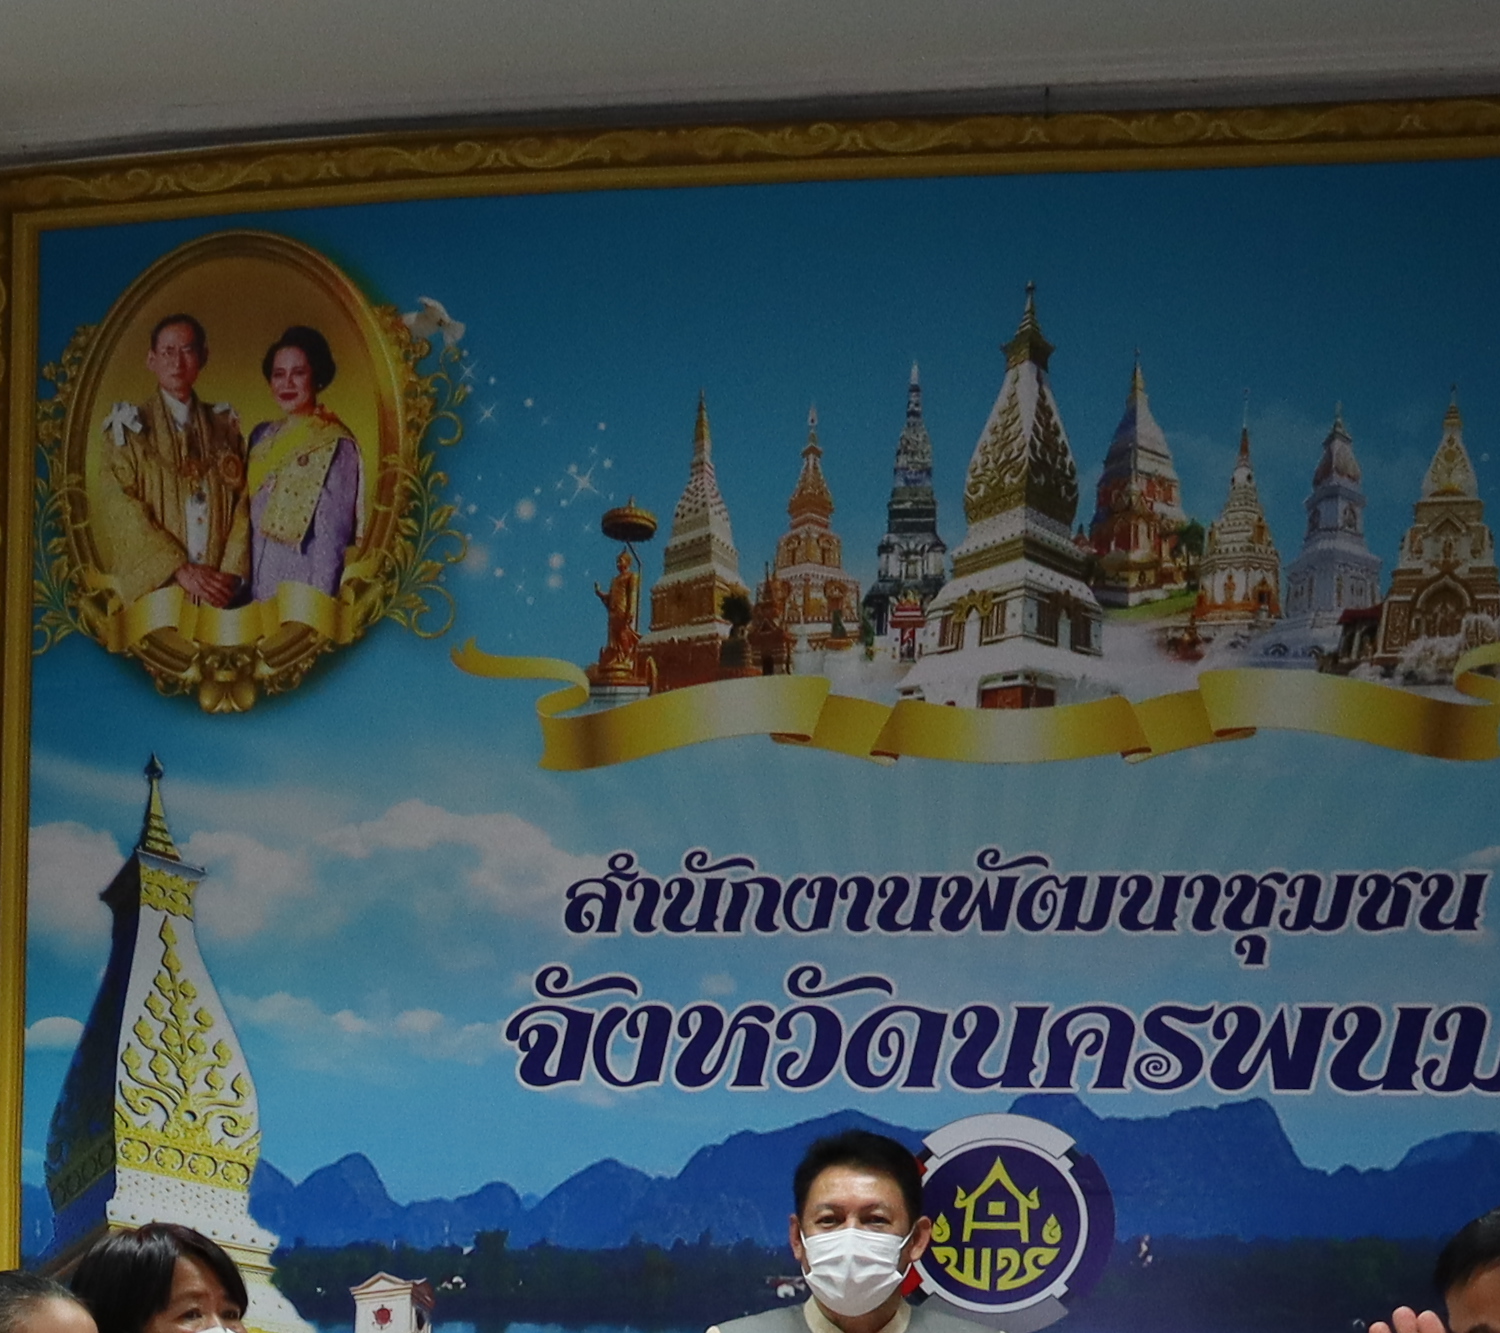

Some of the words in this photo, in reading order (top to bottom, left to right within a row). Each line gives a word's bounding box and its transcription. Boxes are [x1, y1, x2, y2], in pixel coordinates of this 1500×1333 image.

[562, 847, 1490, 967] สำนักงานพัฒนาชุมชน
